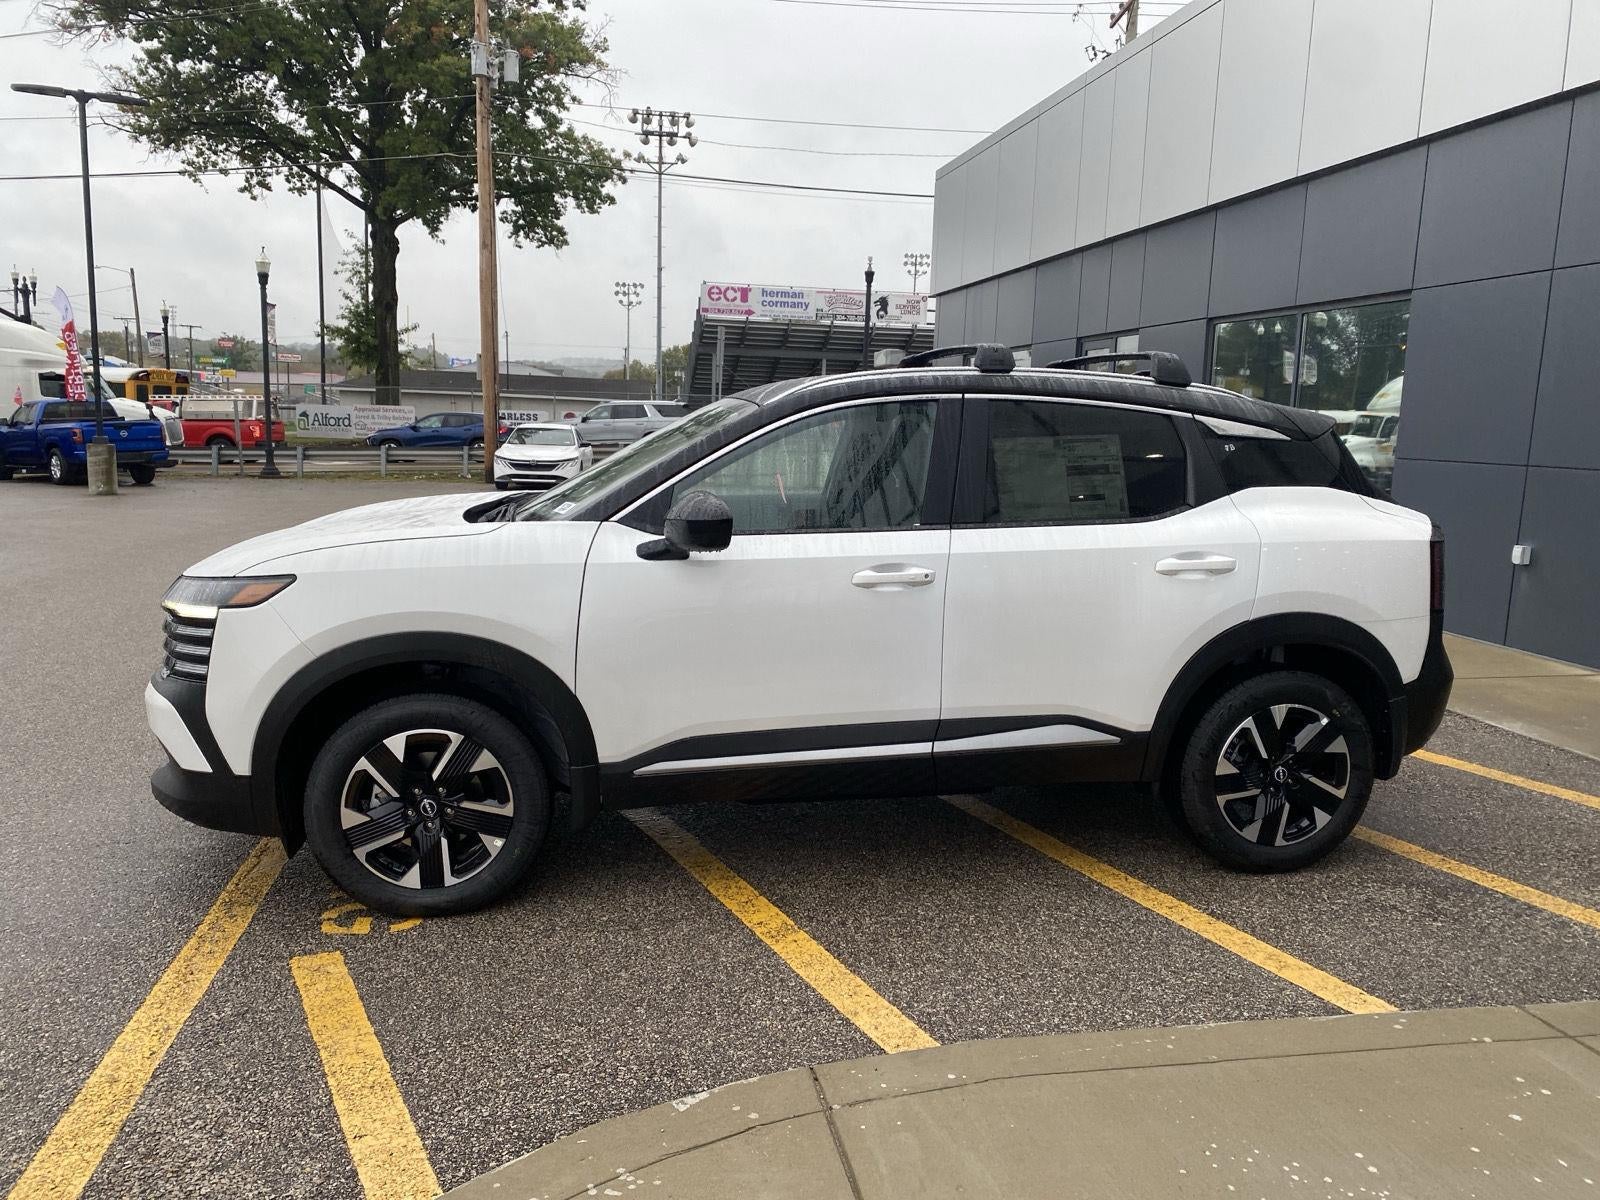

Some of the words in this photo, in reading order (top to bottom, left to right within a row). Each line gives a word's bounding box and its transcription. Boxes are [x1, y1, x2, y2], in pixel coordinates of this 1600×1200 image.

[761, 288, 804, 299] herman
[761, 300, 810, 311] cormany
[311, 412, 352, 427] Alford
